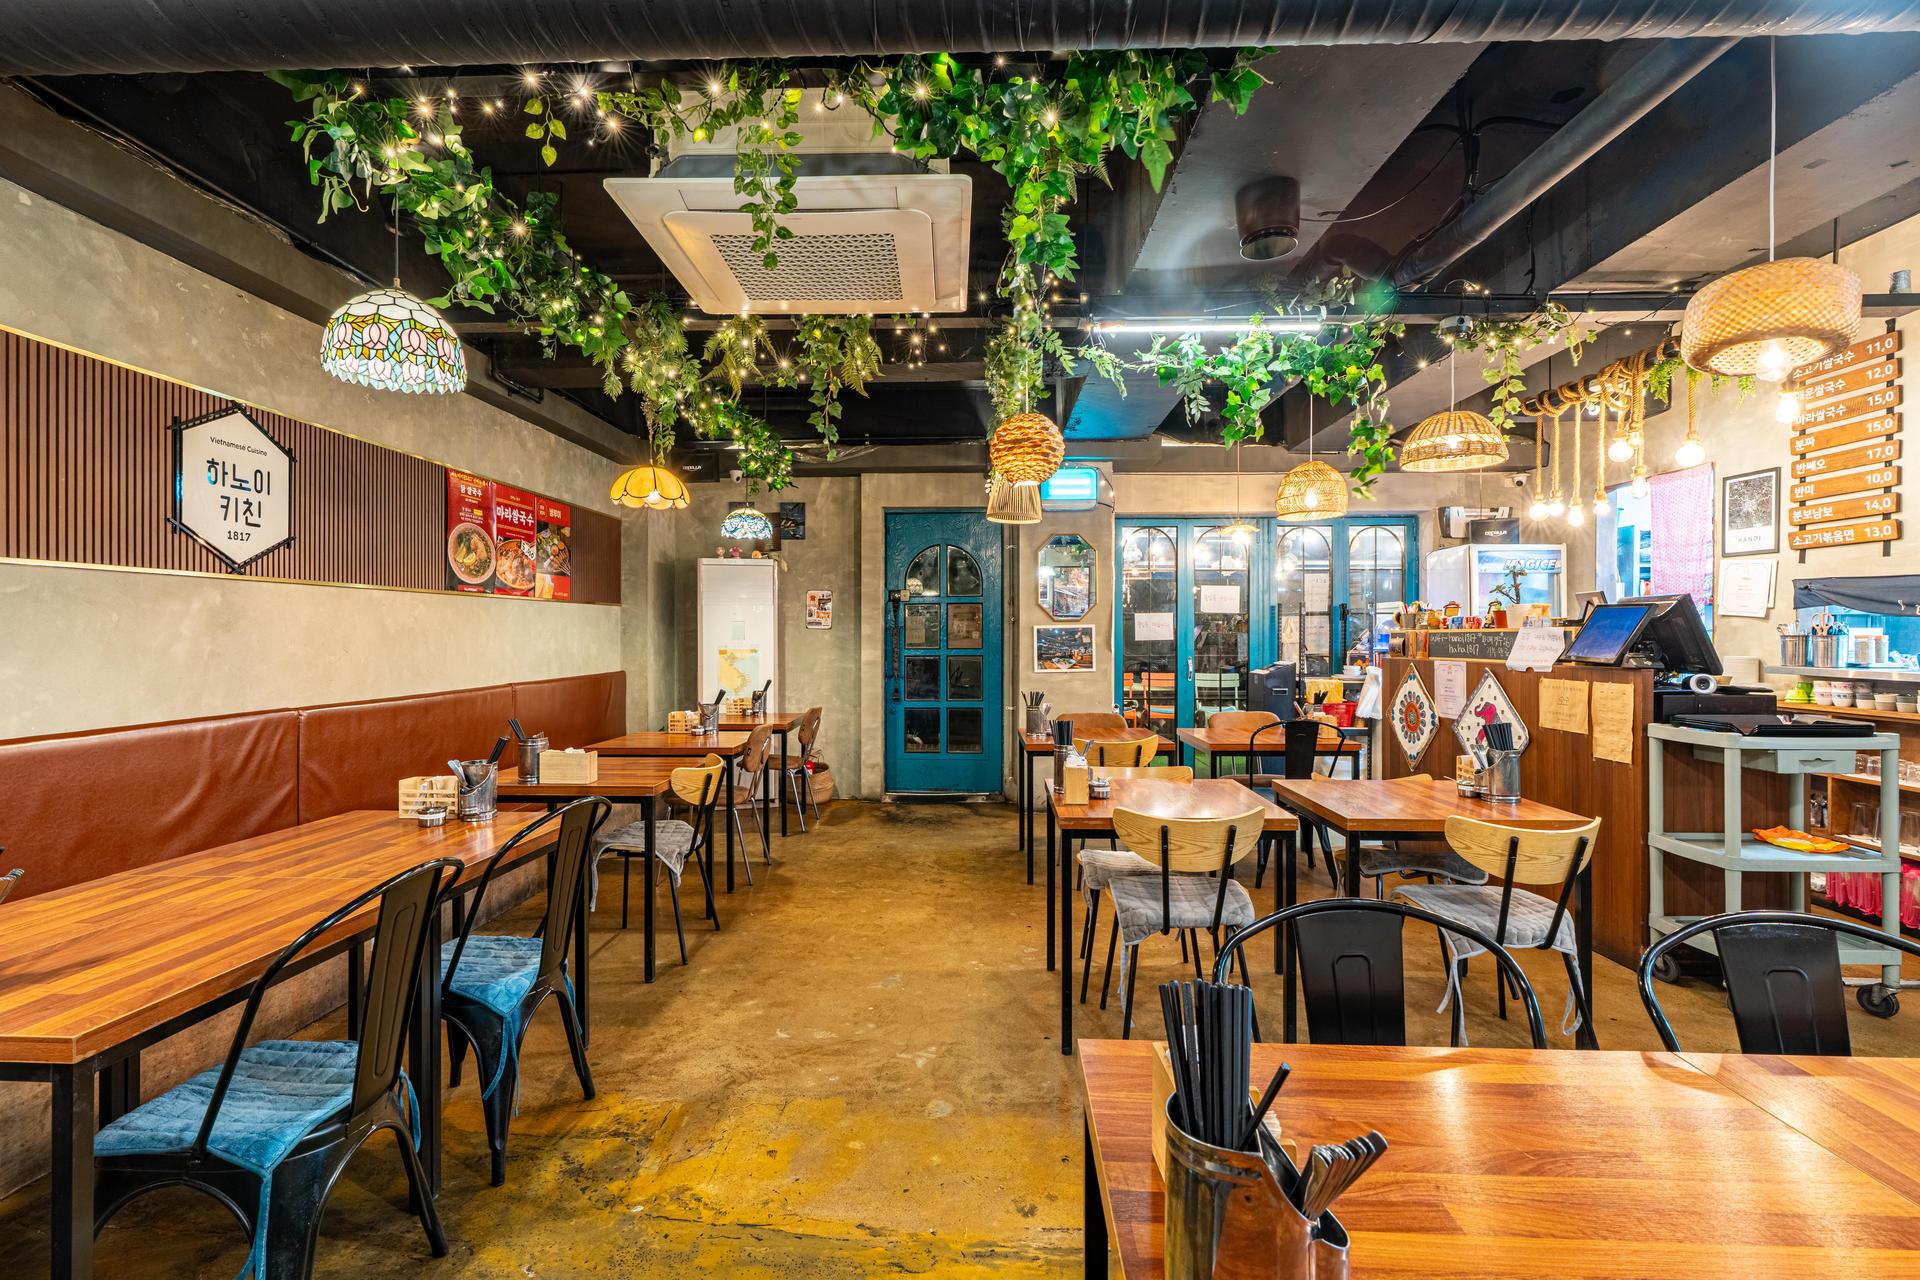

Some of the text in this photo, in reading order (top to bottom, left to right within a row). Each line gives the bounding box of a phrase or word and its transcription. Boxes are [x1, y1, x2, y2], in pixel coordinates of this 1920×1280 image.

[1792, 337, 1894, 379] 소고기쌀국수 11,0
[1866, 363, 1894, 381] 12,0
[1795, 390, 1895, 425] 마라쌀국수 15,0
[1865, 417, 1893, 434] 15,0
[210, 436, 268, 457] Vietnamese Cuisine
[1866, 444, 1894, 460] 17,0
[206, 457, 271, 496] 하노이
[1794, 470, 1893, 499] 반미 10,0
[220, 495, 262, 528] 키친
[496, 505, 535, 527] 마라쌀국수
[1791, 497, 1892, 522] 분보남보 14,0
[227, 530, 251, 542] 1817
[1738, 535, 1762, 543] HANOI
[1792, 525, 1892, 546] 소고기볶음면 13,0
